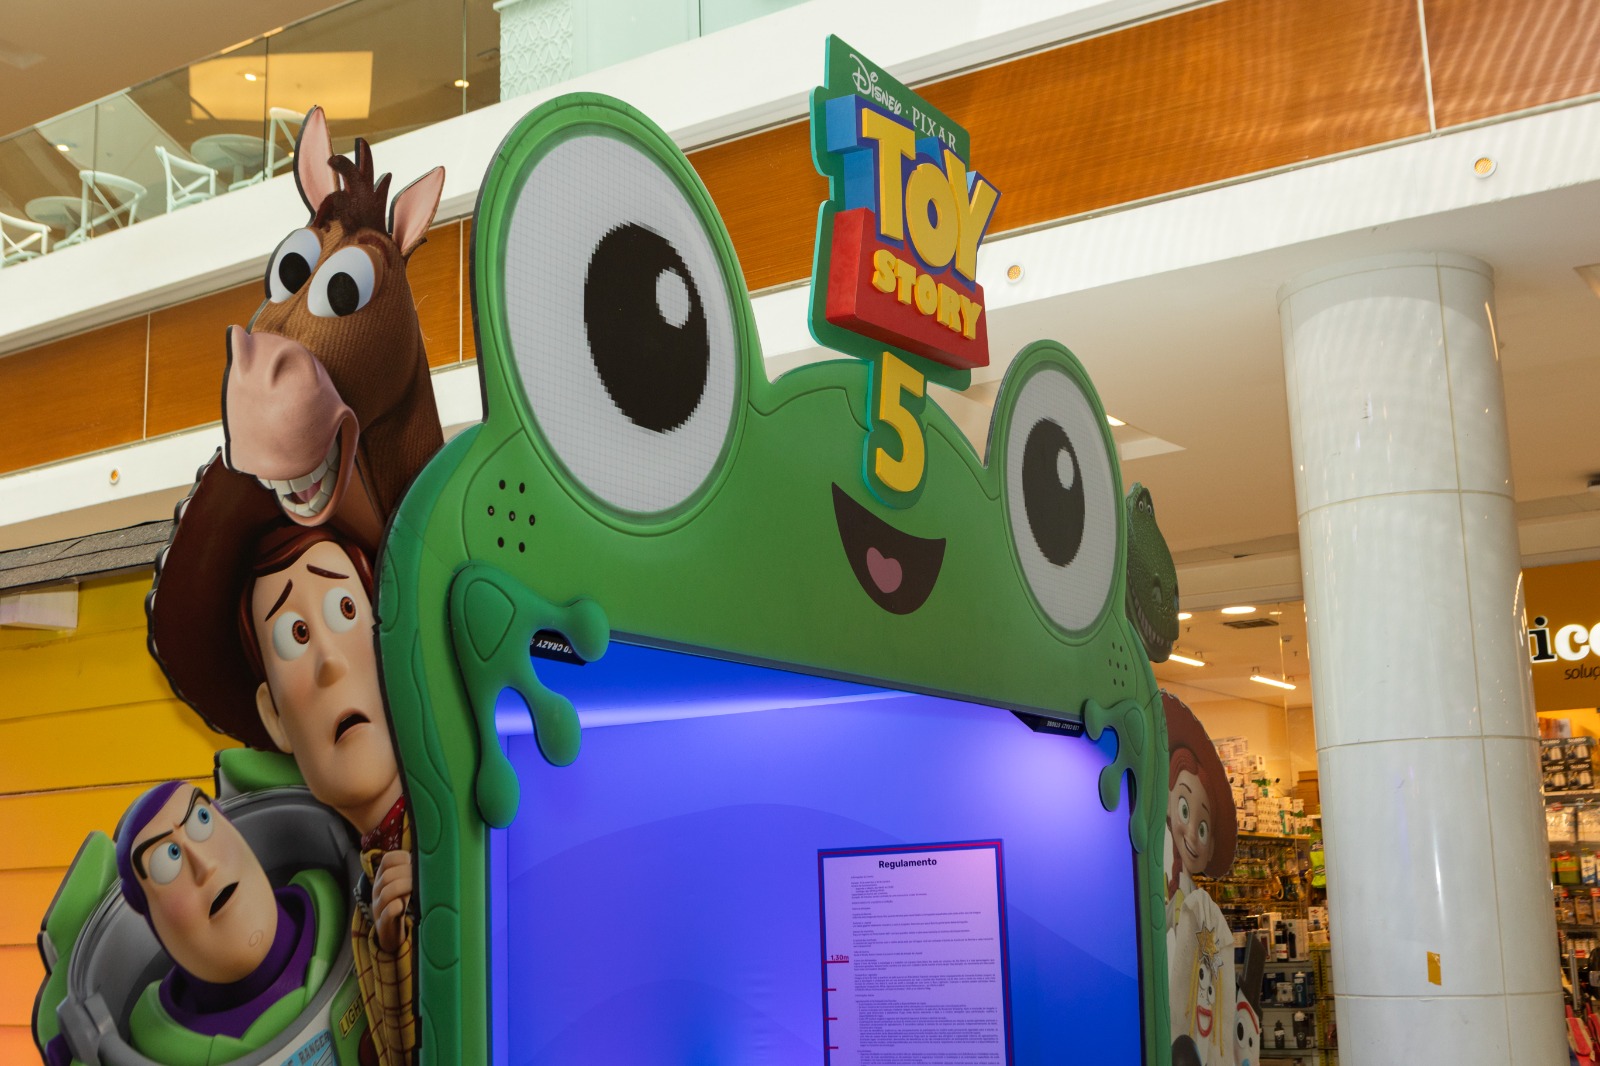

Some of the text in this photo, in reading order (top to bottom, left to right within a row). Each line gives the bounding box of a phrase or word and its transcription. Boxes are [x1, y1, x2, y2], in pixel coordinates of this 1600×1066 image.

[912, 105, 956, 151] PIXAR
[860, 106, 999, 282] TOY
[872, 248, 983, 340] STORY
[875, 351, 926, 493] 5
[536, 640, 563, 651] CRAZY
[878, 857, 938, 870] Regulamento
[340, 994, 363, 1035] LIGH
